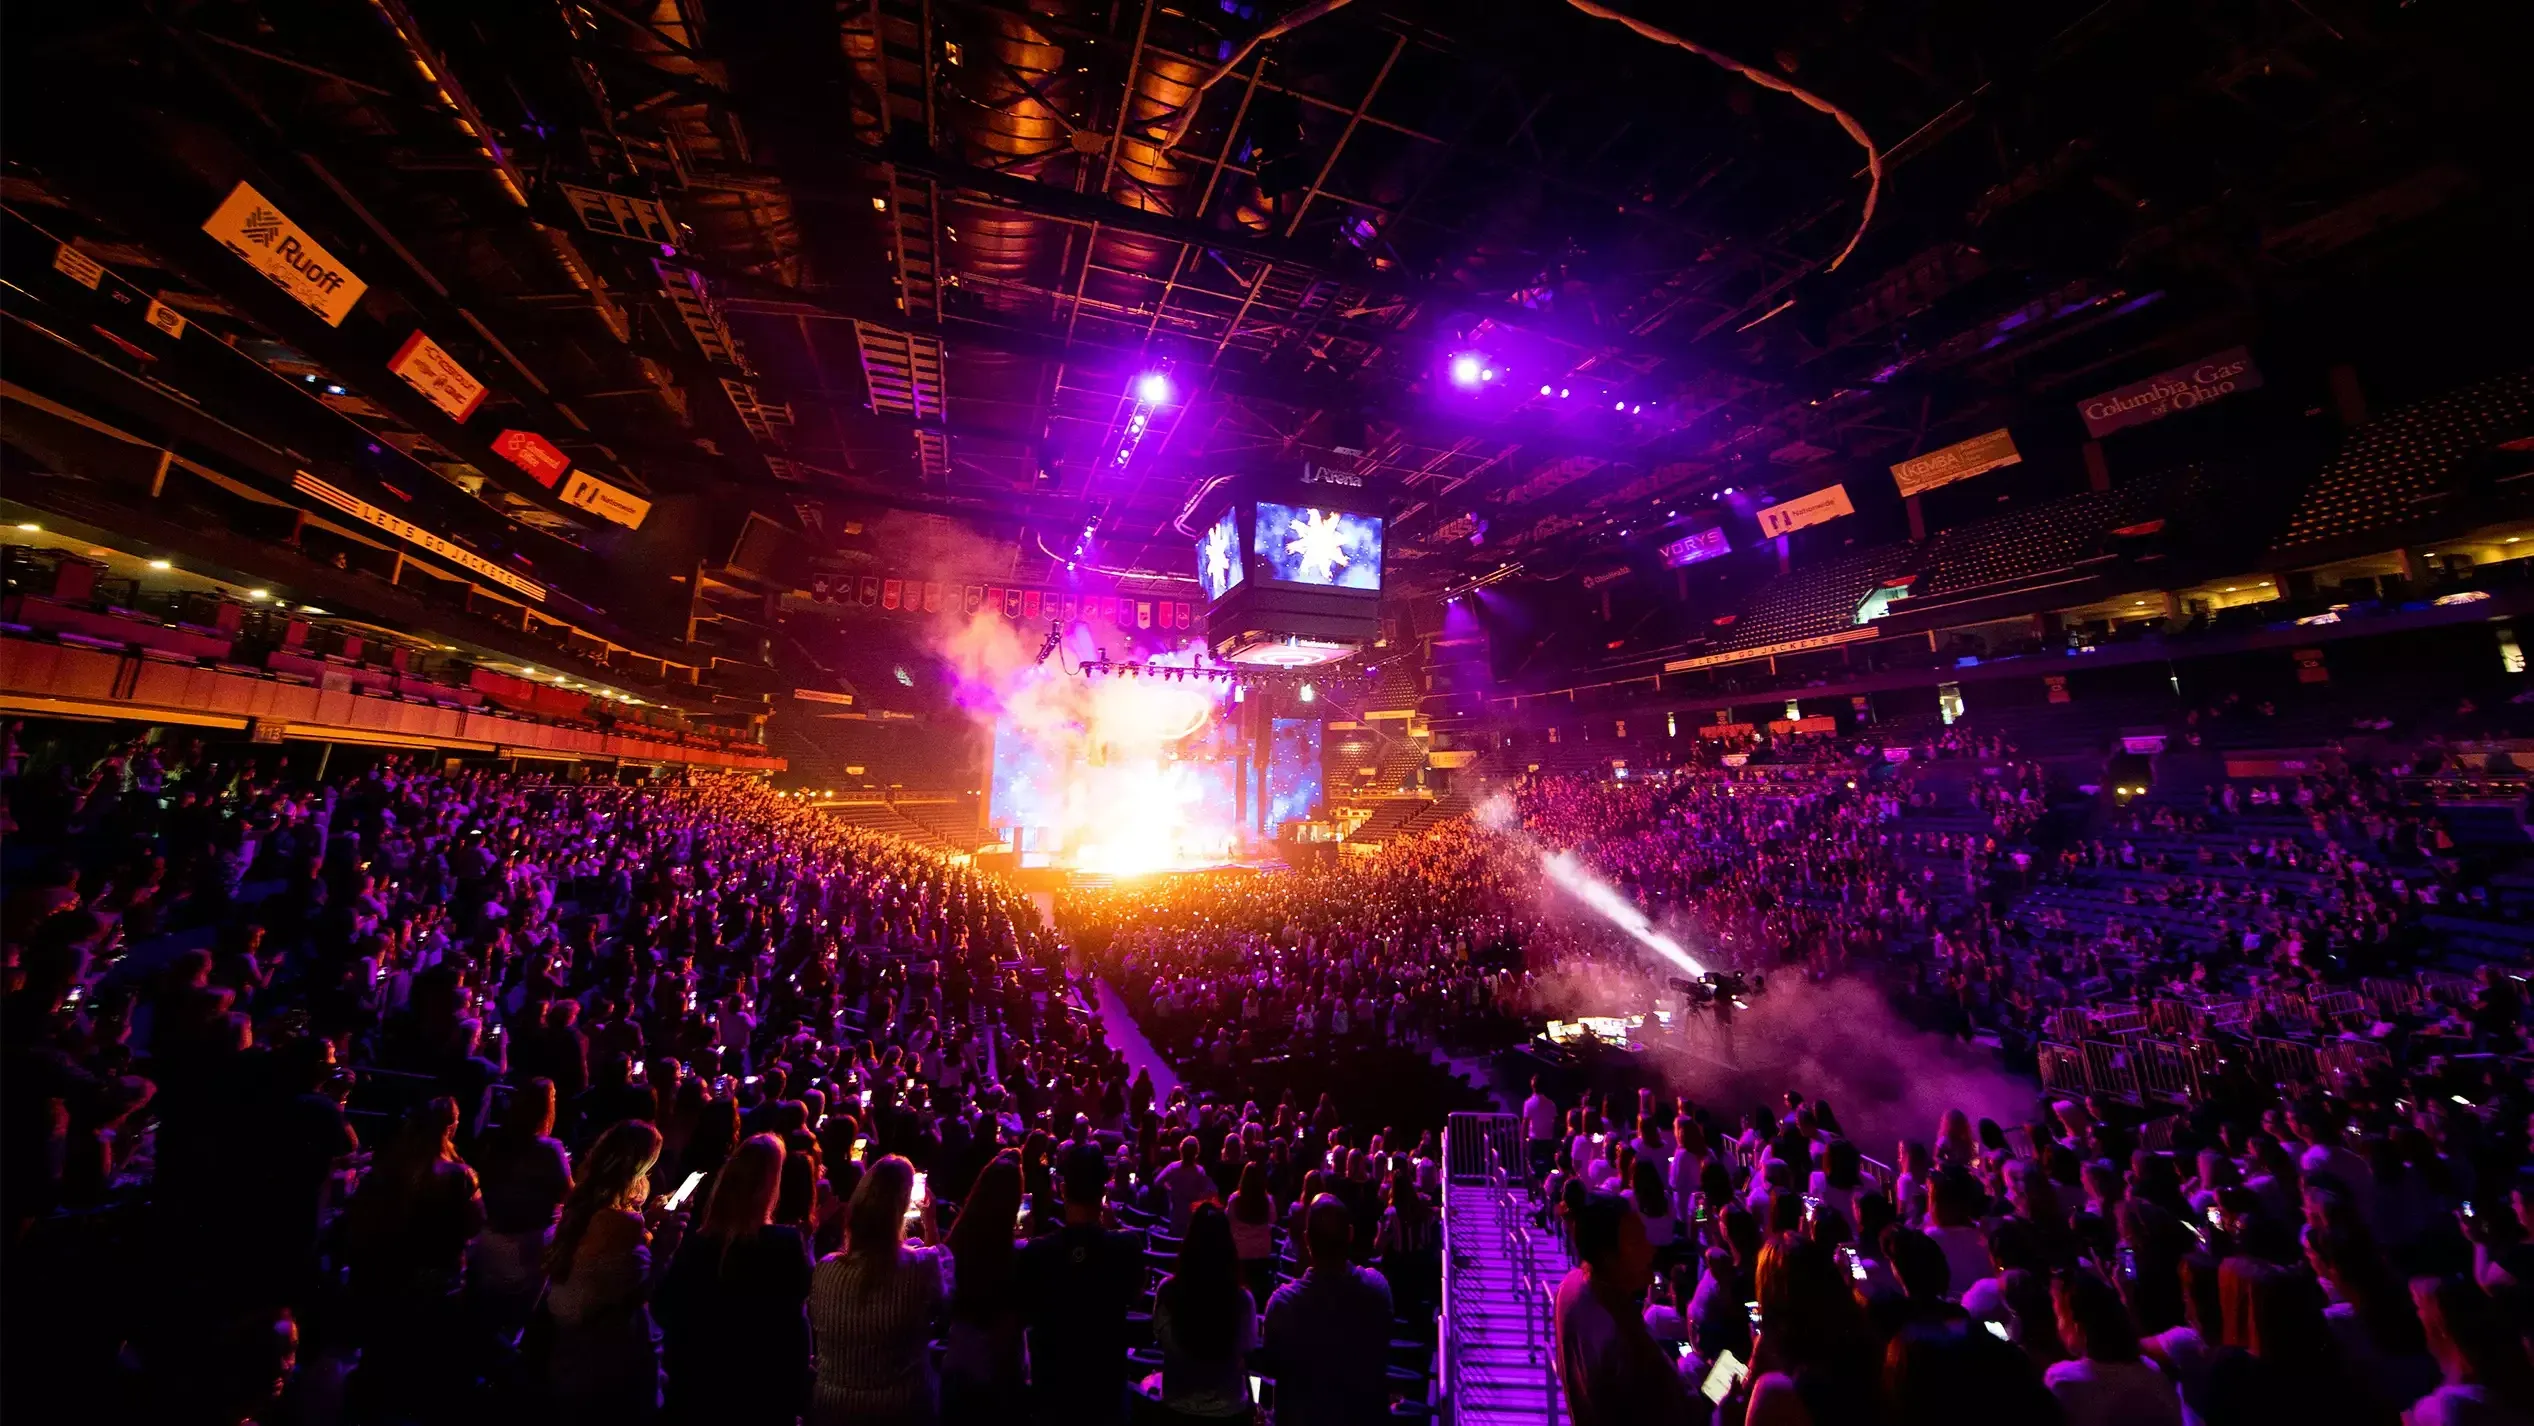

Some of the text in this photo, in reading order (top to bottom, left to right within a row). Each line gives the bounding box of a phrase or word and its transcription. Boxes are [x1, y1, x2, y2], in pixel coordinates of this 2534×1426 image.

[276, 235, 345, 295] Ruoff
[2085, 360, 2244, 420] Columbia Gas
[2151, 381, 2236, 416] of Ohio
[1907, 453, 1960, 477] KEMBA
[1792, 499, 1835, 517] Nationwide
[1659, 531, 1720, 557] VORYS
[425, 535, 445, 552] GO
[451, 545, 513, 584] JACKETS
[1762, 637, 1830, 655] JACKETS
